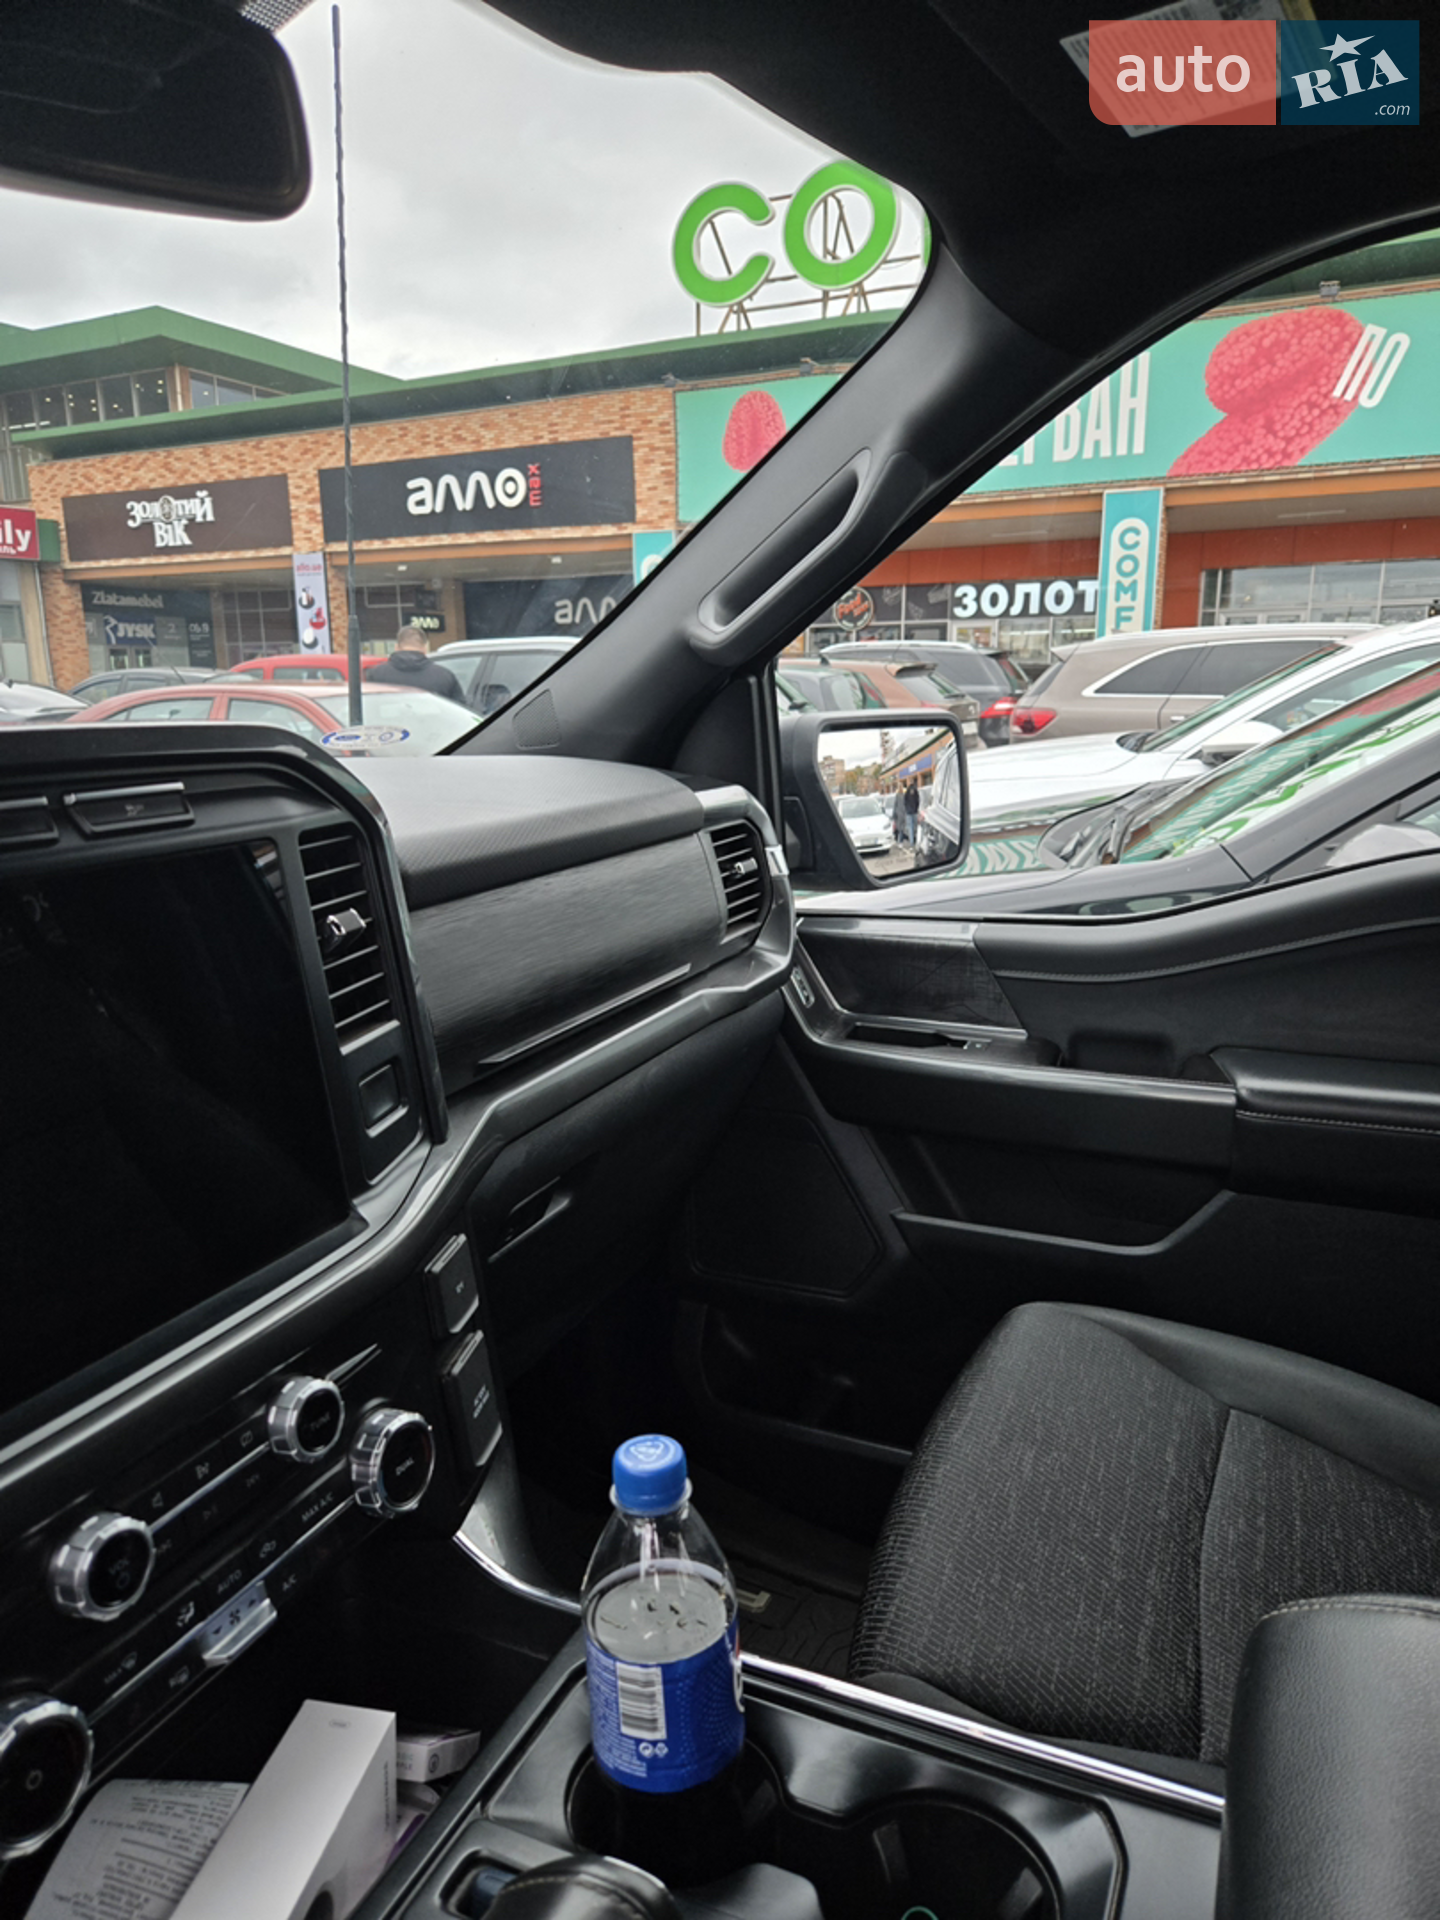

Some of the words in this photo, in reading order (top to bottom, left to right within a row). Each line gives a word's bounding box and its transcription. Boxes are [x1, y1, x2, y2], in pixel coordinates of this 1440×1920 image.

[672, 158, 932, 307] CO
[117, 623, 156, 638] JYSK
[217, 1568, 243, 1594] AUTO
